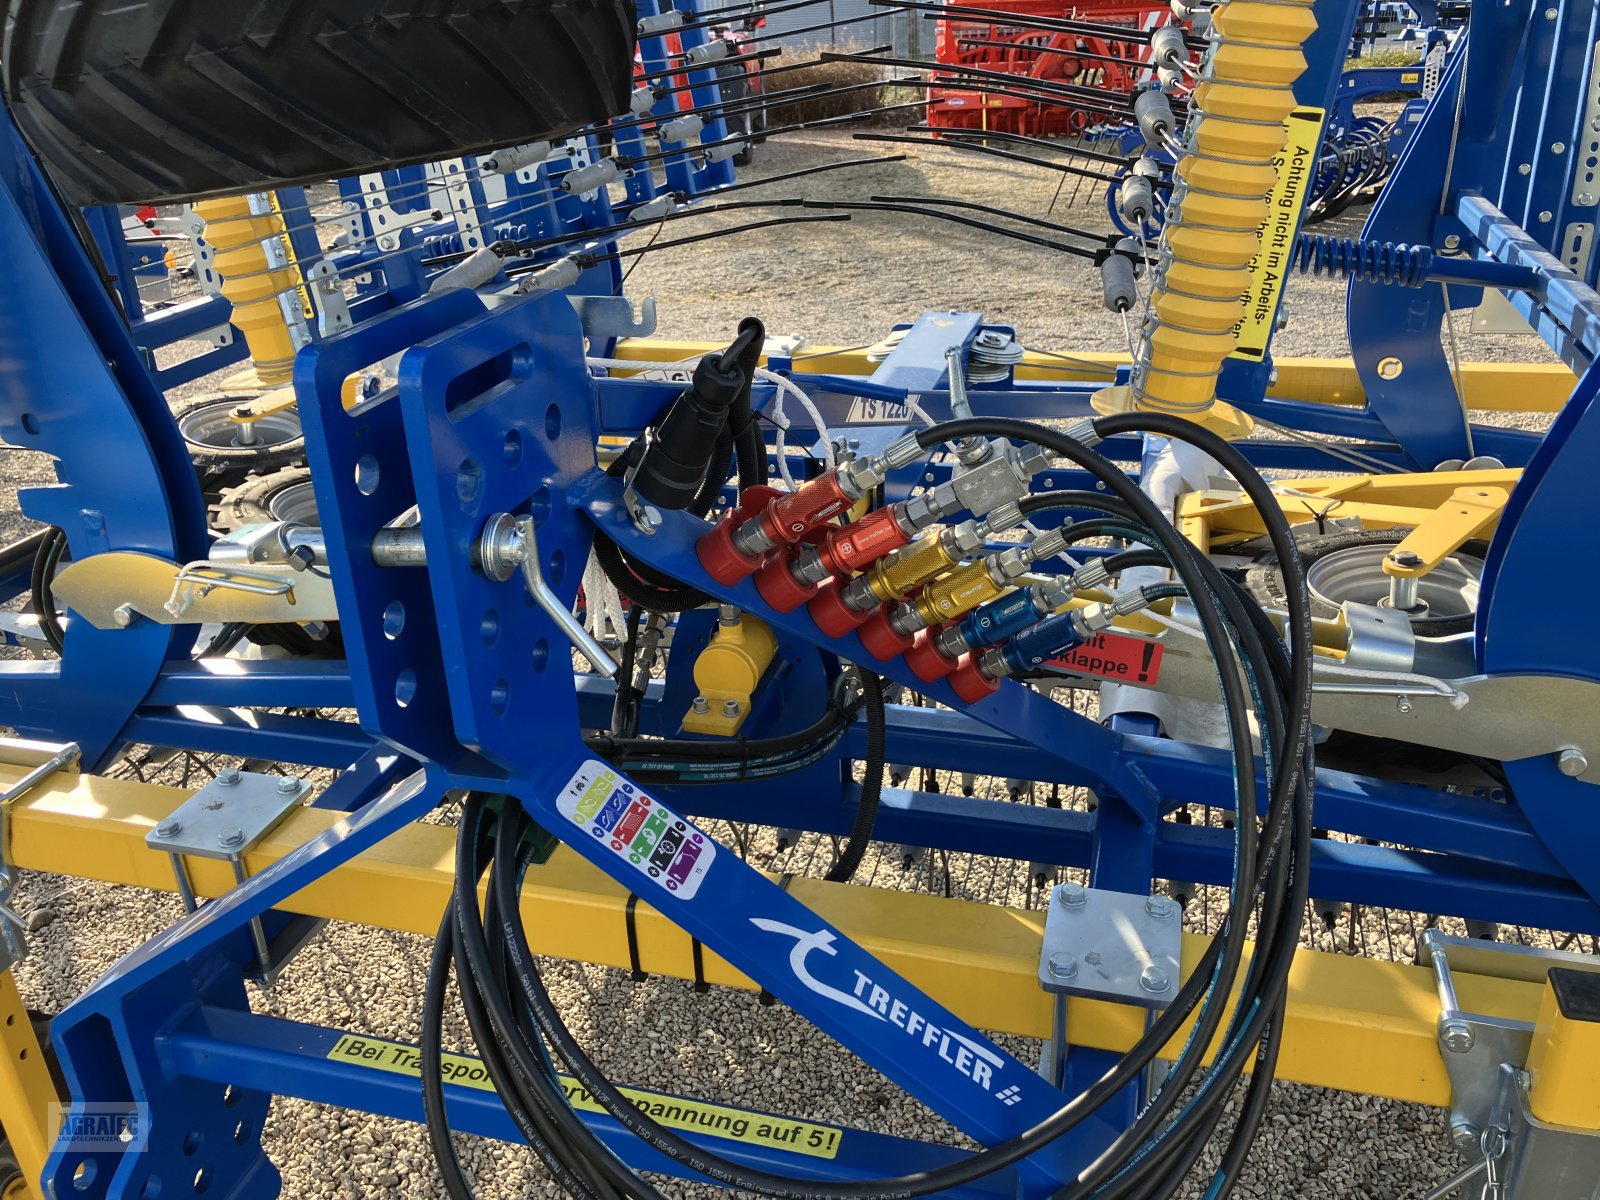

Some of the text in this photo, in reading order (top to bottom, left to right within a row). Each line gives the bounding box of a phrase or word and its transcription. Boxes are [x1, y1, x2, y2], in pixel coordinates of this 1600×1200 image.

[1254, 145, 1310, 325] Achtung nicht im Arbeits-
[860, 400, 876, 419] TS
[853, 969, 993, 1091] TREFFLER
[503, 922, 522, 967] LP122222
[591, 1084, 611, 1104] 212F
[610, 1103, 633, 1126] Meets
[636, 1124, 651, 1138] ISO
[653, 1137, 678, 1156] 15540
[688, 1158, 705, 1171] ISO
[708, 1167, 732, 1182] 15541
[735, 1178, 787, 1197] Engineered
[880, 1190, 911, 1200] Poland
[514, 1109, 536, 1140] Poland
[756, 1122, 803, 1144] auf
[807, 1129, 837, 1151] 5!
[545, 1153, 562, 1174] Made
